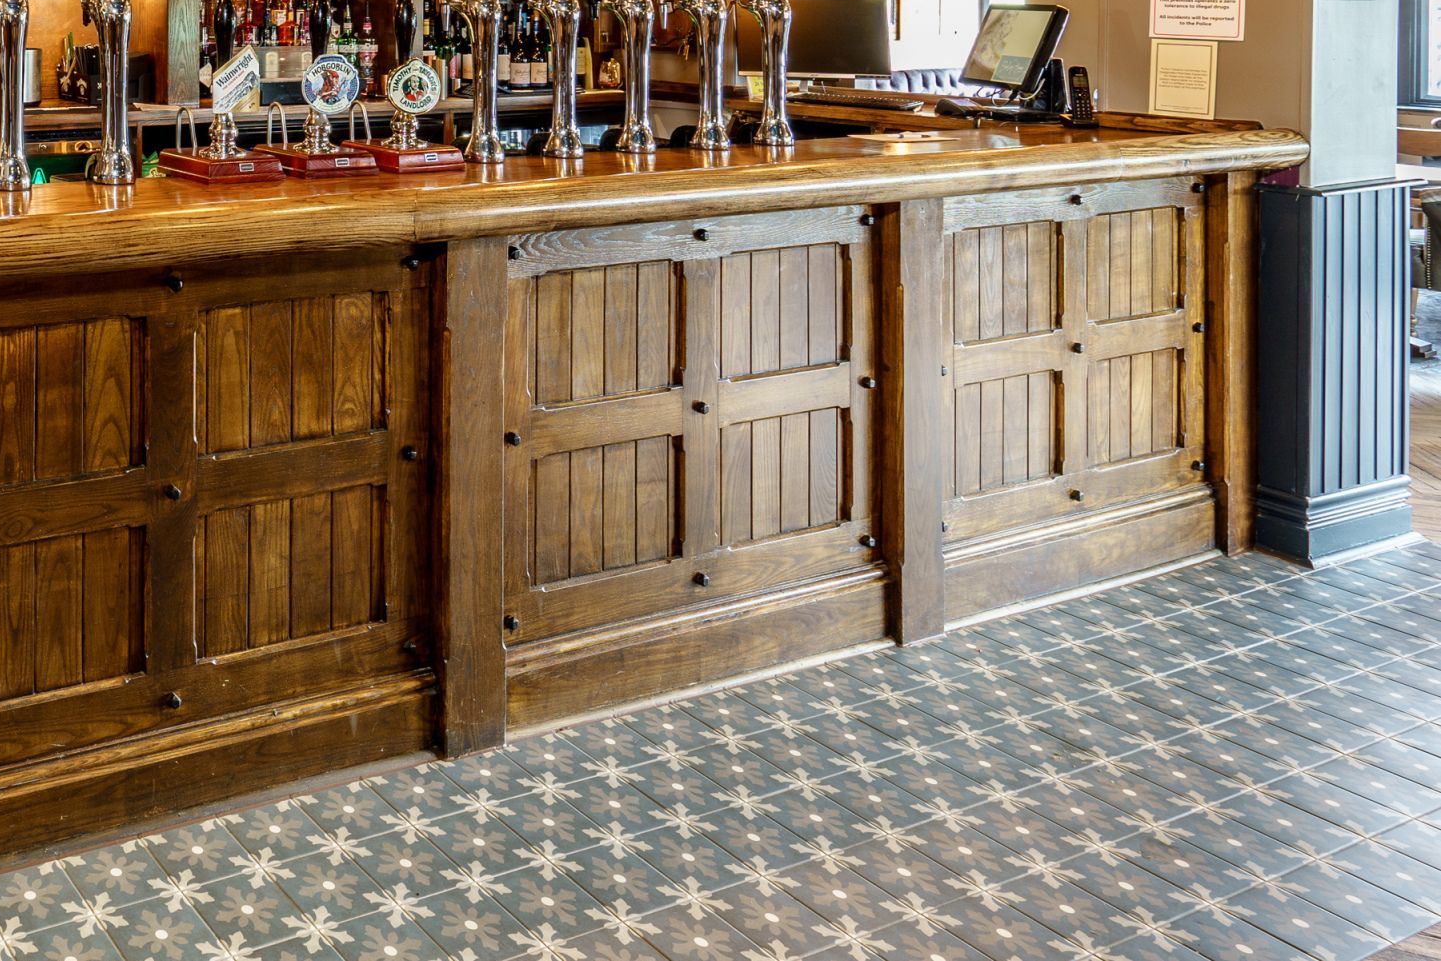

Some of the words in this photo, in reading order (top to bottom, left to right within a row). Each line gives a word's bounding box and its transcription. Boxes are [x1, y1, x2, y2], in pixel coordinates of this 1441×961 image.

[216, 53, 253, 88] Wainwright
[312, 62, 351, 77] HOBGOBLIN
[393, 66, 412, 92] TIMOTHY
[400, 95, 432, 109] LANDLORD
